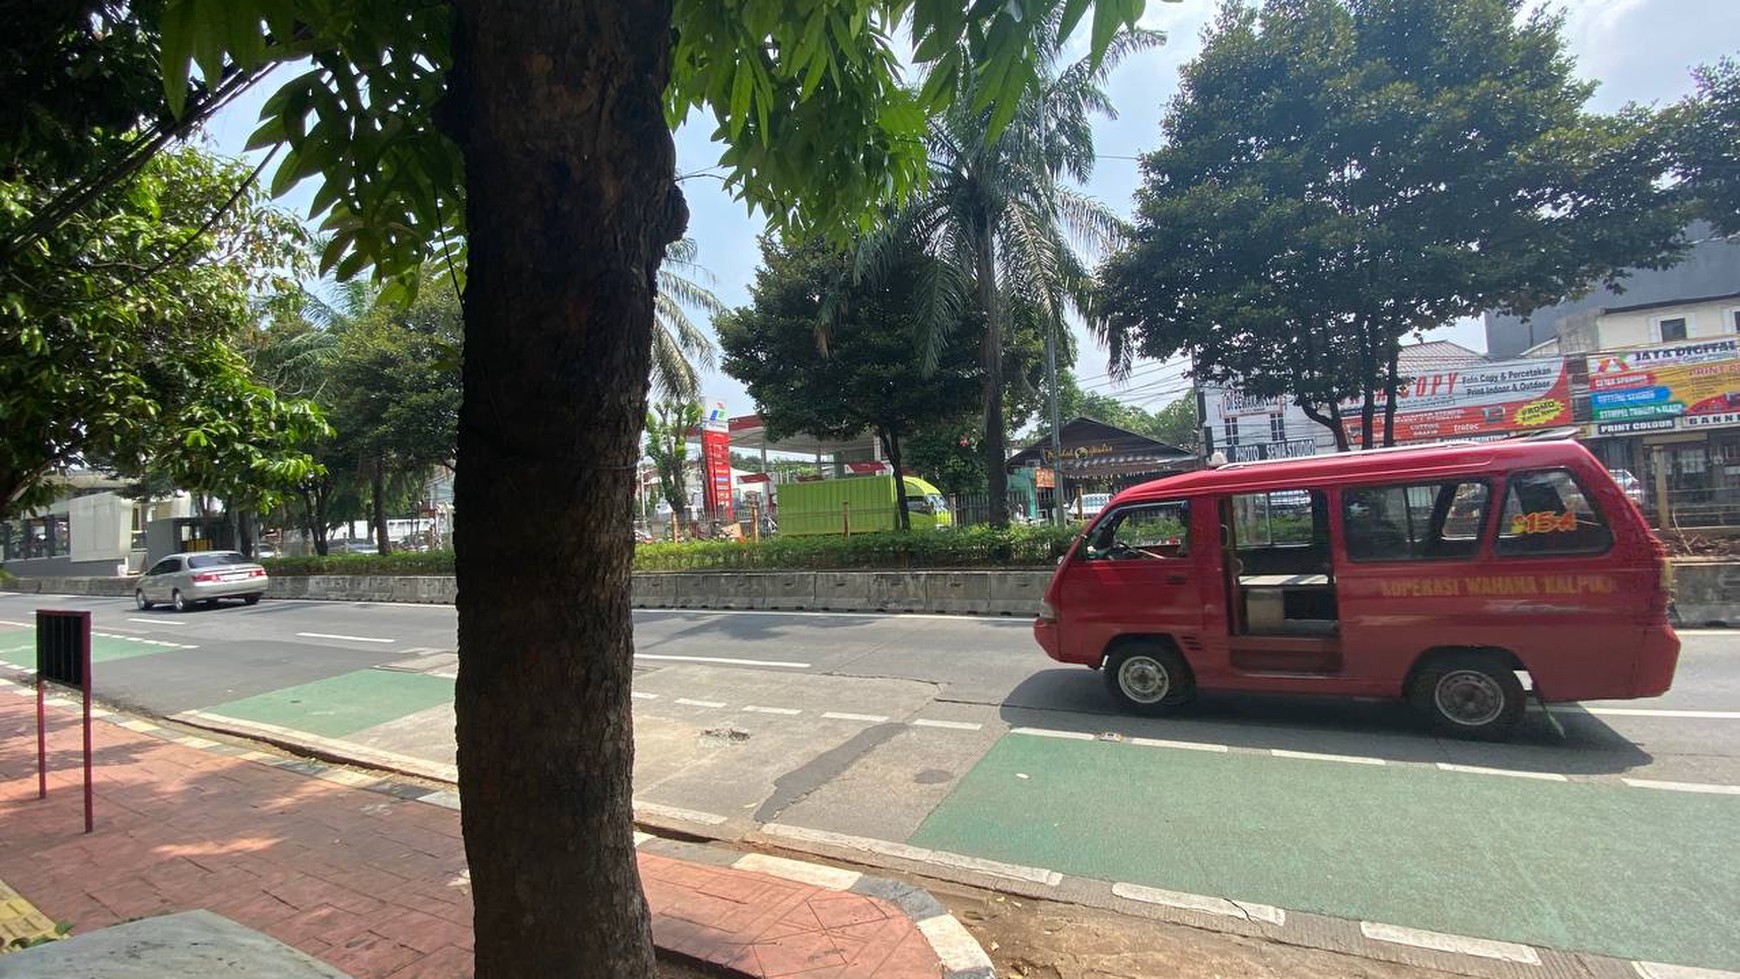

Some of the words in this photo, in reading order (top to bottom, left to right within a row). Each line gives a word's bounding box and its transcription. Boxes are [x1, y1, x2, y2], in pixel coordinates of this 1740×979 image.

[1676, 341, 1736, 357] DIGITAL
[1480, 374, 1499, 383] Copy
[1509, 367, 1552, 379] Percetakan
[1467, 387, 1484, 396] Print
[1485, 385, 1510, 394] Indoor
[1519, 381, 1551, 391] Outdoor
[1521, 400, 1555, 416] PROMO
[1600, 423, 1631, 433] PRINT
[1632, 420, 1673, 430] COLOUR
[1235, 445, 1260, 462] PHOTO
[1287, 440, 1314, 458] STUDIO
